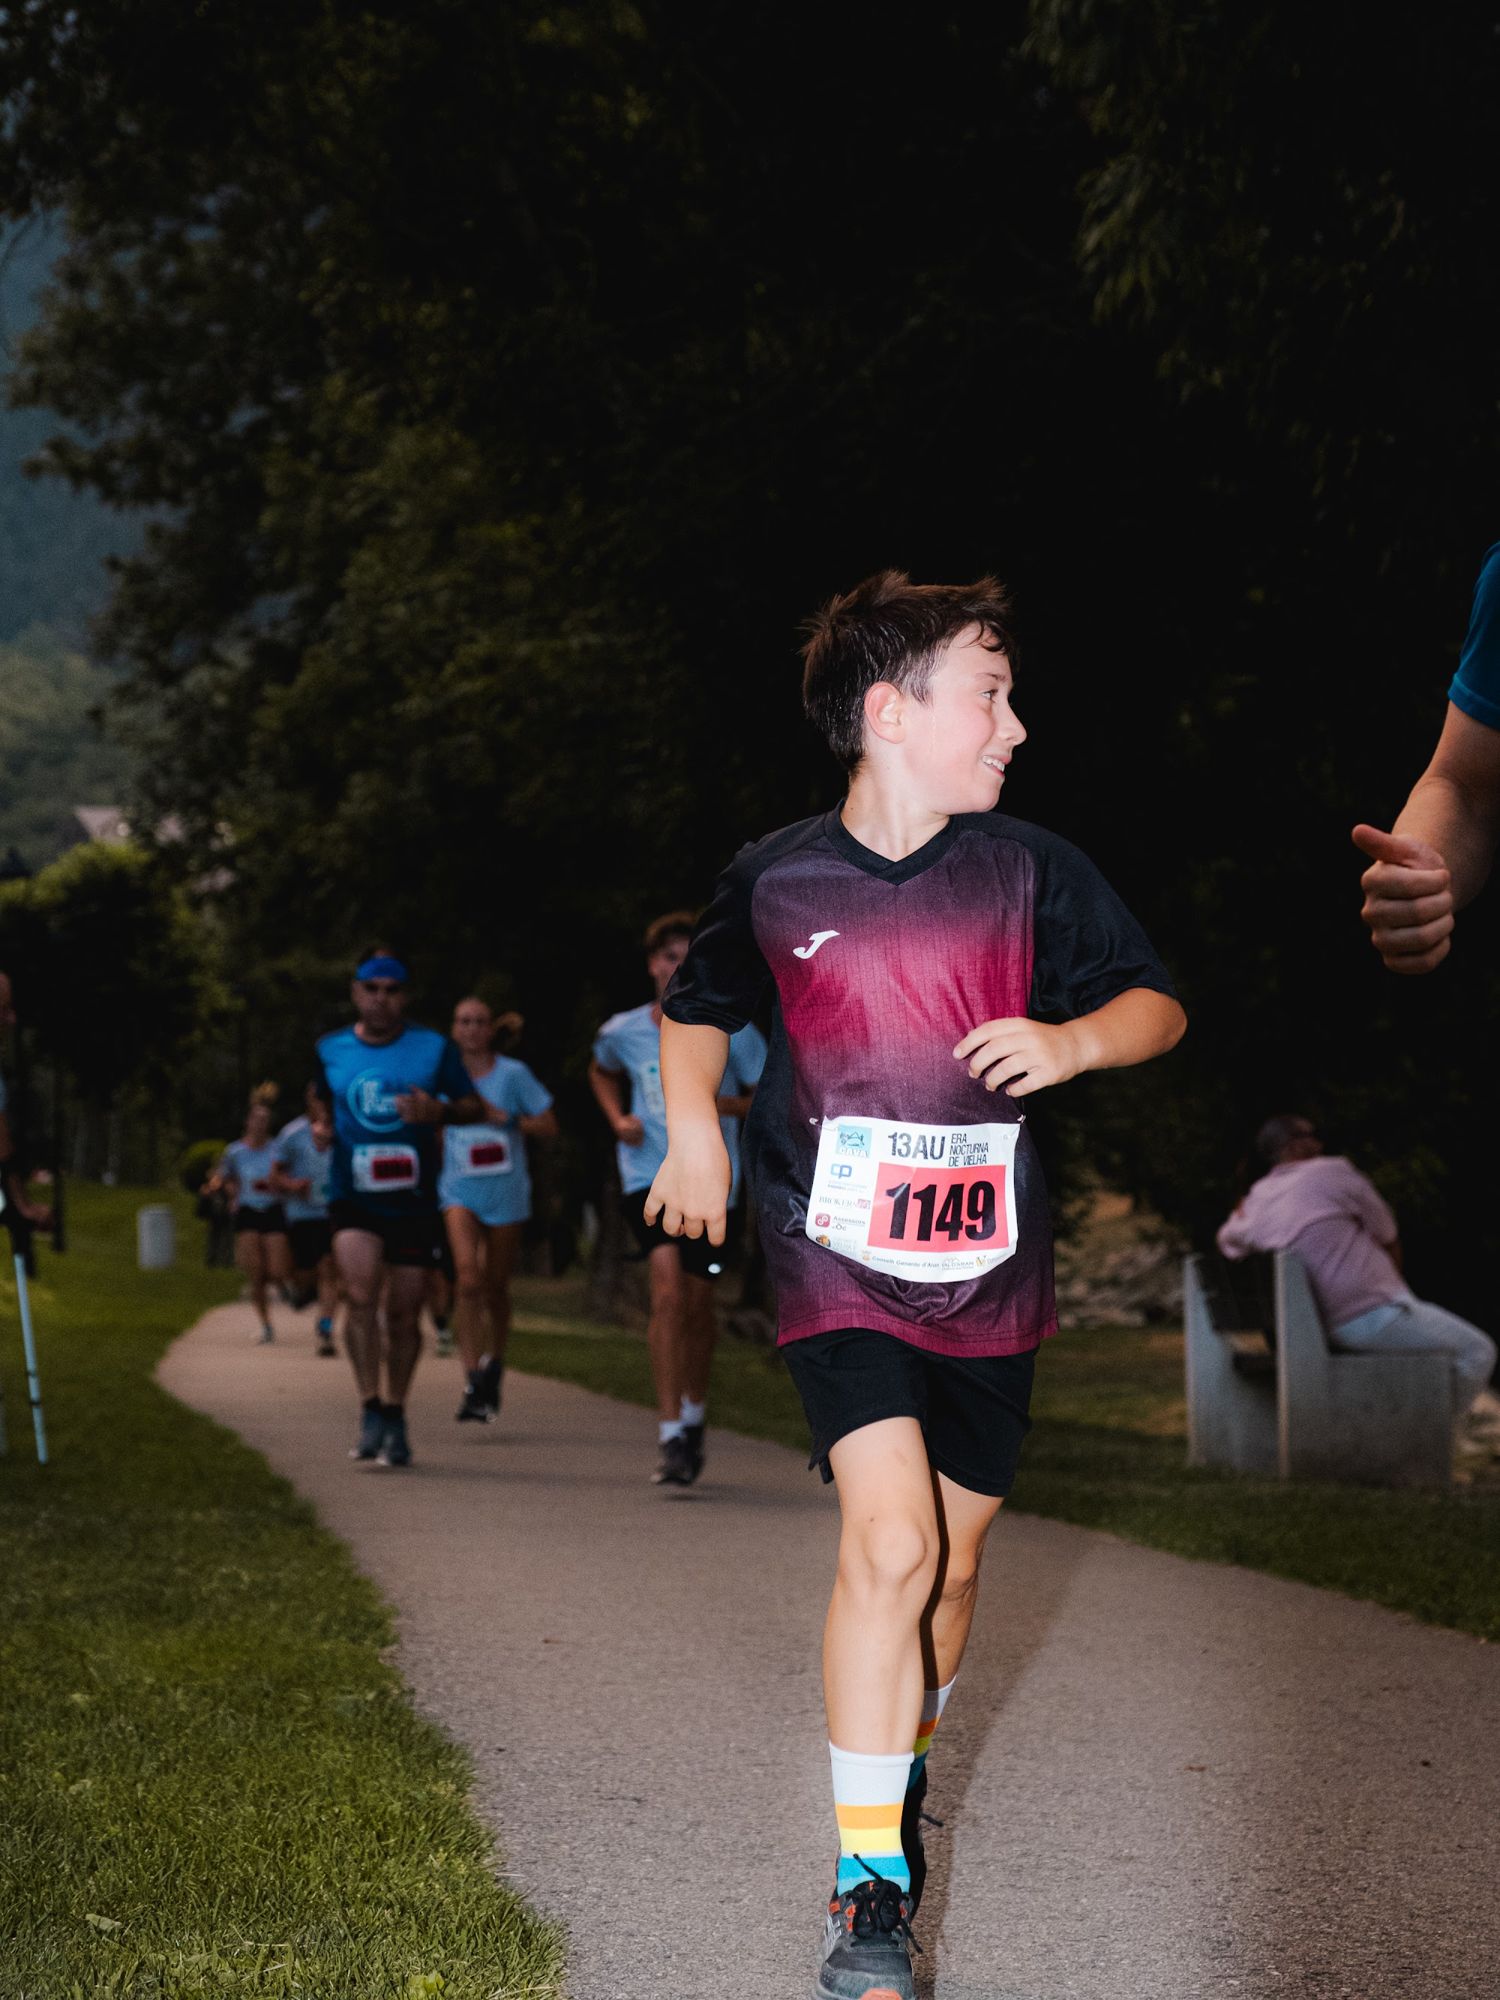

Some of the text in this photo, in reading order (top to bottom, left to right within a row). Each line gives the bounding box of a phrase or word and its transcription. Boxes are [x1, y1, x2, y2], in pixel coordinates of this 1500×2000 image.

[951, 1133, 967, 1144] ERA
[949, 1142, 989, 1156] NOCTURNA
[948, 1154, 988, 1167] DE VIELHA
[885, 1180, 997, 1242] 1149
